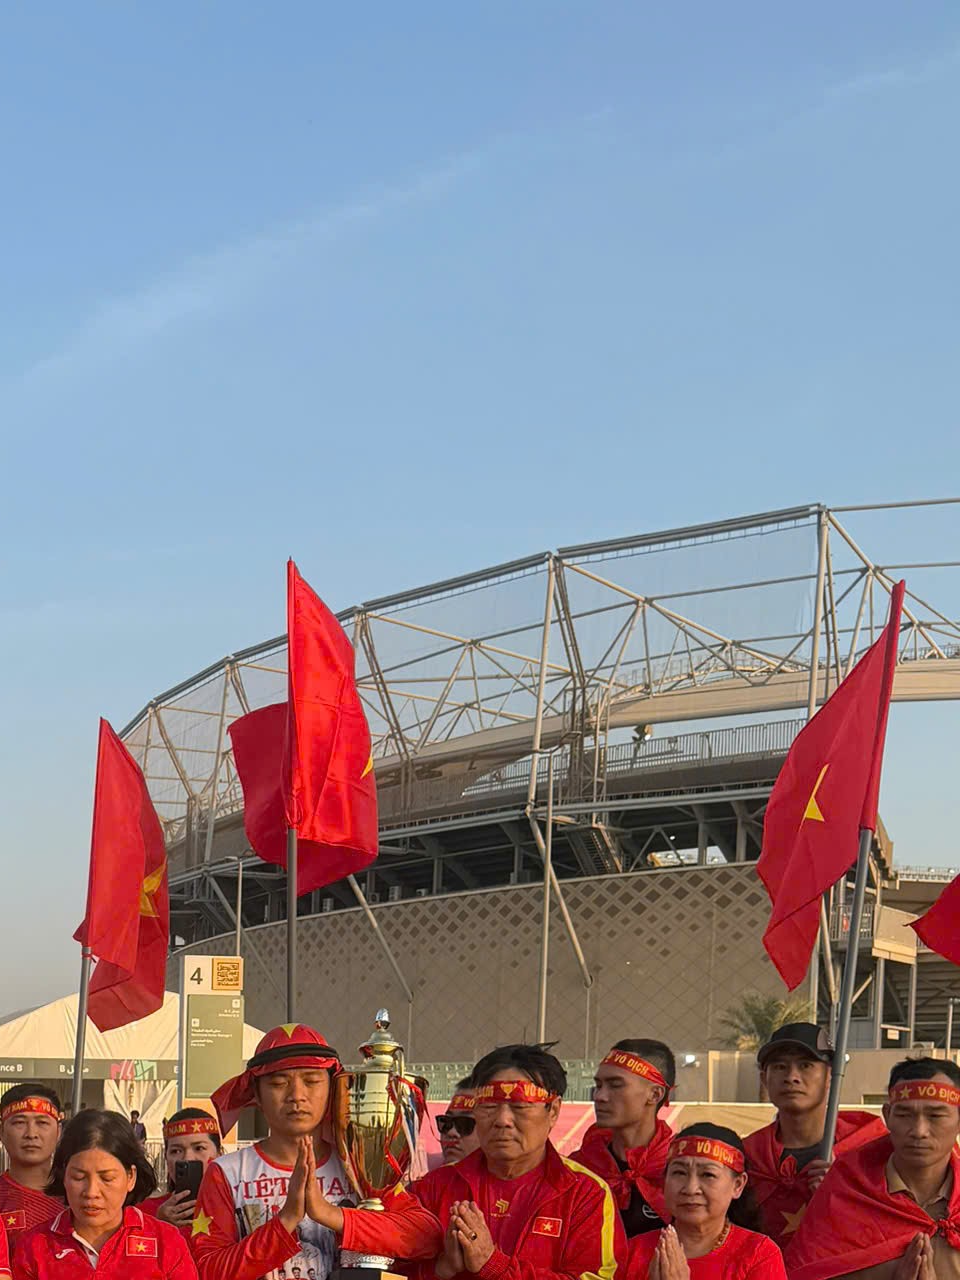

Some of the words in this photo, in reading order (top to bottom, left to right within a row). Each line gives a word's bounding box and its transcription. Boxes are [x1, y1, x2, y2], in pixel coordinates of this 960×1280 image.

[190, 967, 203, 985] 4
[16, 1064, 23, 1073] B
[59, 1064, 66, 1073] B
[917, 1083, 937, 1097] VÔ
[696, 1140, 712, 1154] VÔ
